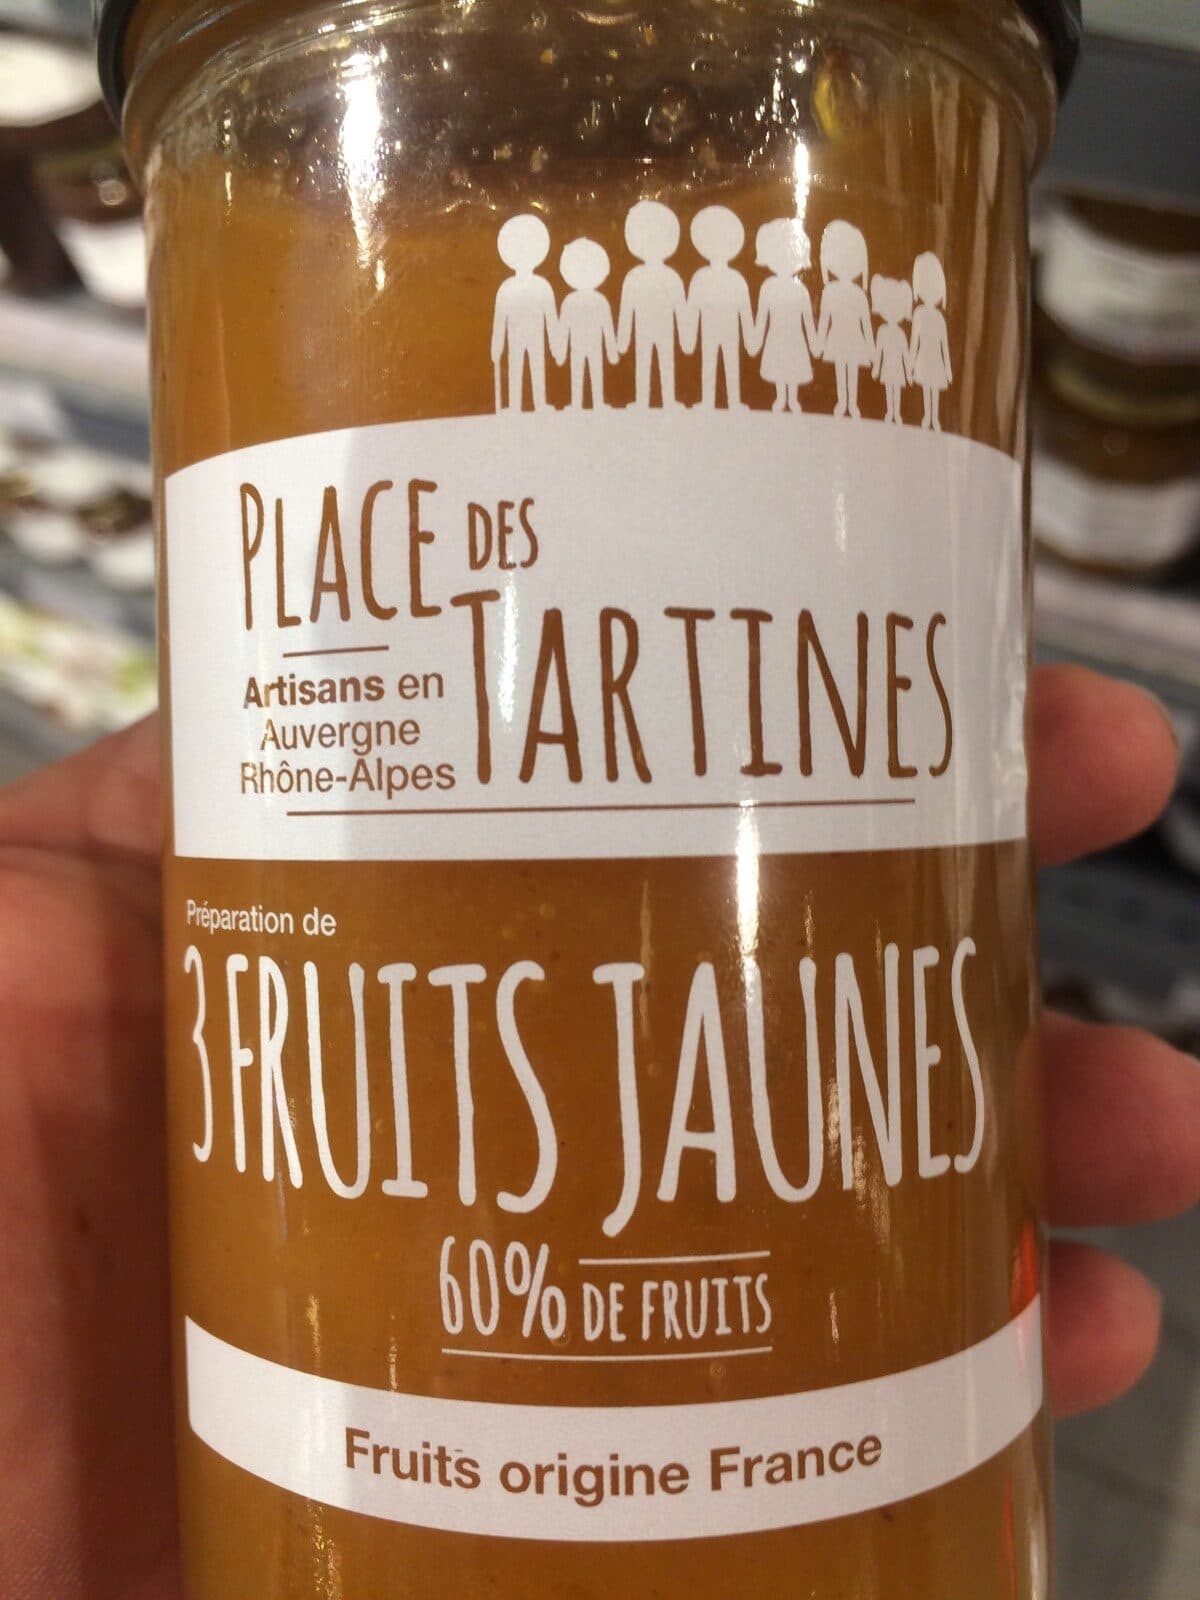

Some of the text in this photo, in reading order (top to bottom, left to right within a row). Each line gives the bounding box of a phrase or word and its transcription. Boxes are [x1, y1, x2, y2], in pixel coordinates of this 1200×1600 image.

[239, 477, 539, 630] PLACE DES
[243, 672, 444, 709] Artisans en
[450, 589, 953, 785] TARTINES
[260, 718, 420, 755] Auvergne
[240, 757, 456, 799] Rhône-Alpes
[186, 899, 337, 936] Préparation de
[184, 936, 985, 1238] 3 FRUITS JAUNES
[439, 1235, 773, 1342] 60% DE FRUITS
[345, 1426, 882, 1508] Fruits origine France
